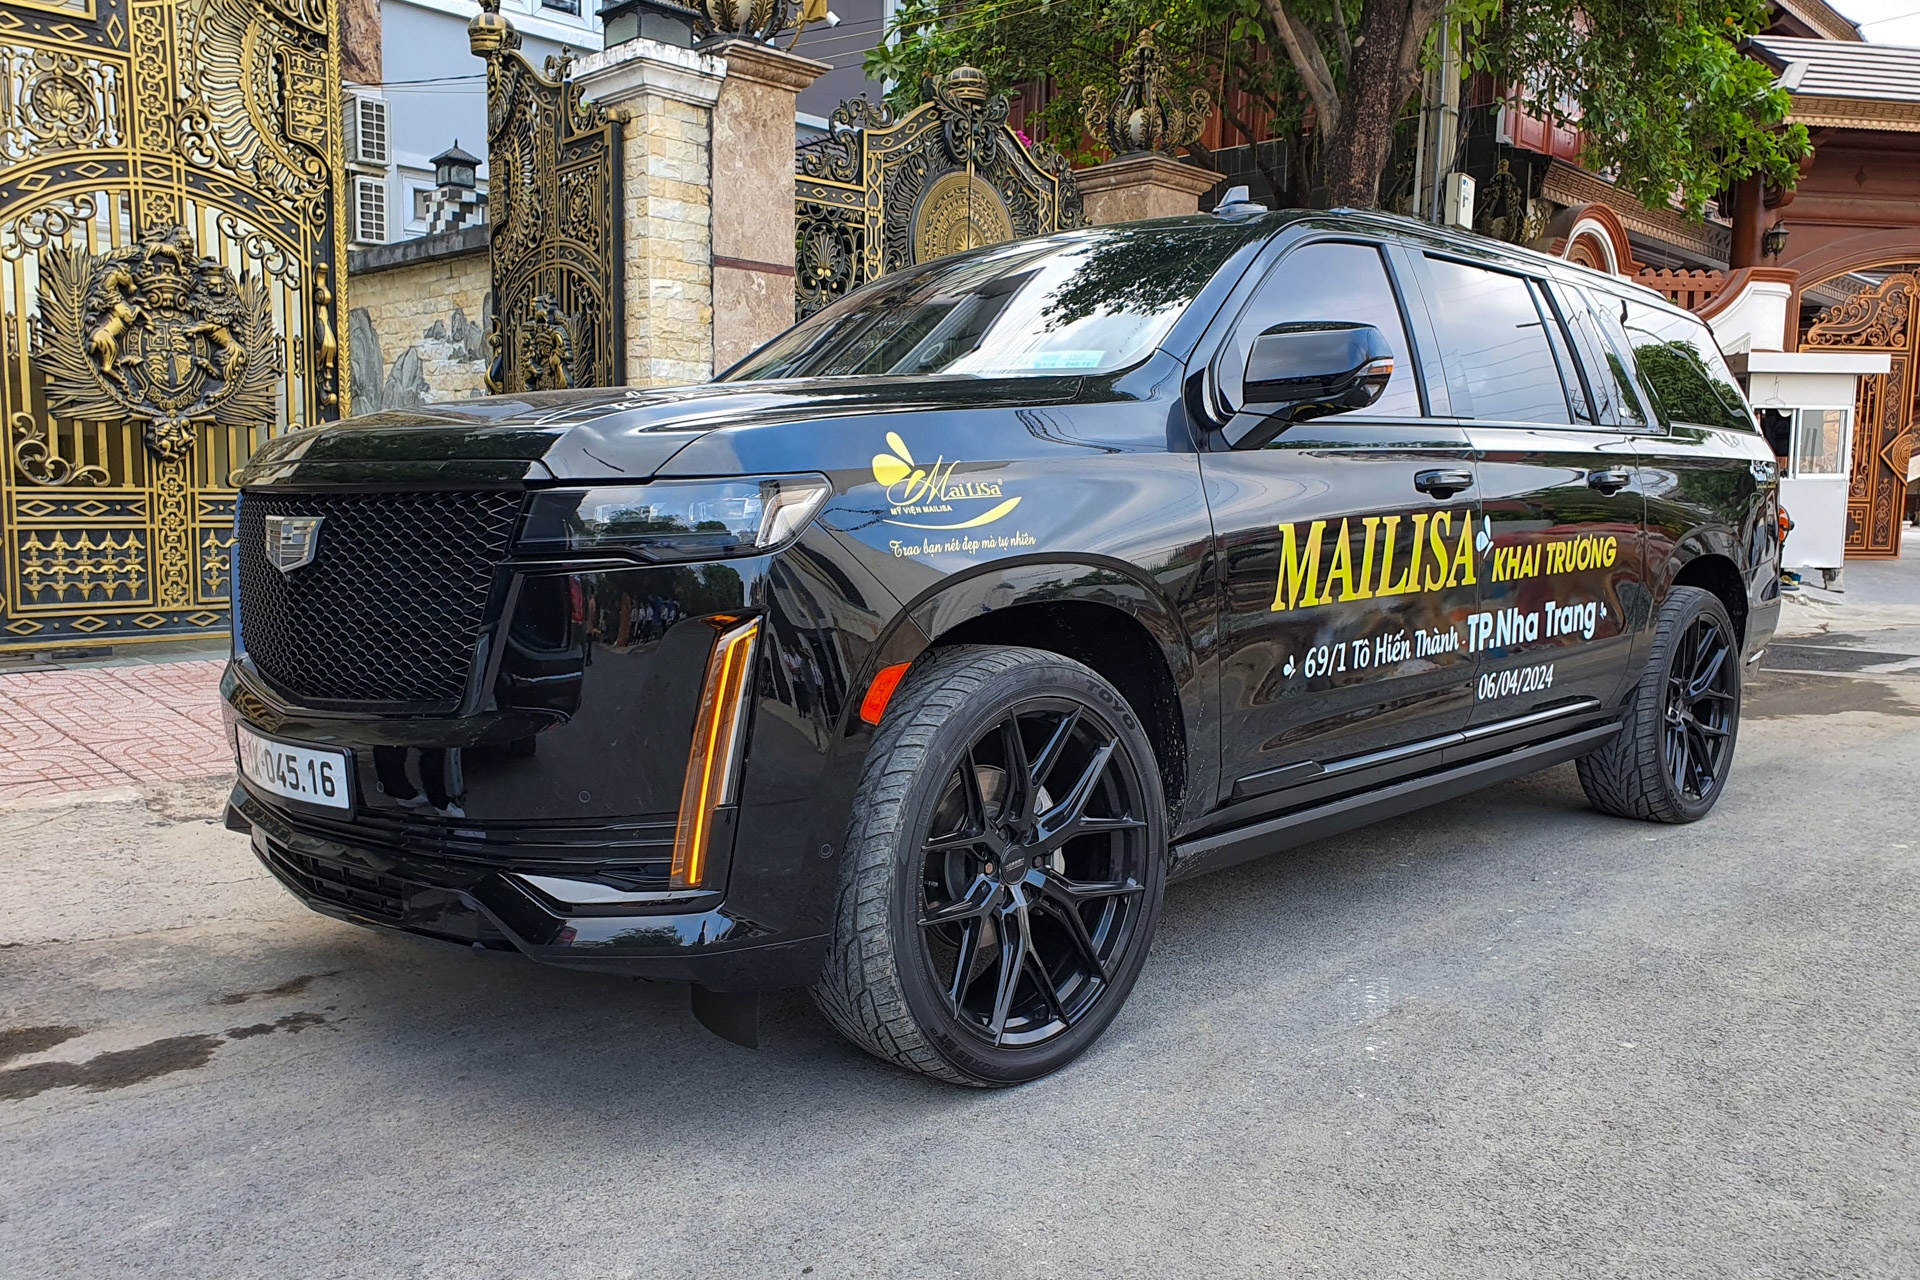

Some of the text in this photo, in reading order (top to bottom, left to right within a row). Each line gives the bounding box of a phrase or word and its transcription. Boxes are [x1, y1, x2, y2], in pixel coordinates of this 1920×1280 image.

[922, 504, 953, 513] MAILISA
[889, 540, 921, 558] Trao
[923, 538, 942, 557] bạn
[944, 538, 960, 552] nét
[962, 535, 980, 555] đẹp
[981, 534, 997, 549] mà
[1010, 530, 1036, 546] nhiên
[1271, 509, 1476, 612] MAILISA
[1491, 534, 1618, 583] KHAI TRƯƠNG
[1304, 640, 1346, 678] 69/1
[1352, 640, 1370, 670] Tô
[1374, 629, 1411, 668] Hiến
[1415, 626, 1459, 658] Thành
[1544, 600, 1597, 640] Trang
[1086, 678, 1136, 731] TOYO
[1478, 663, 1554, 700] 06/04/2024
